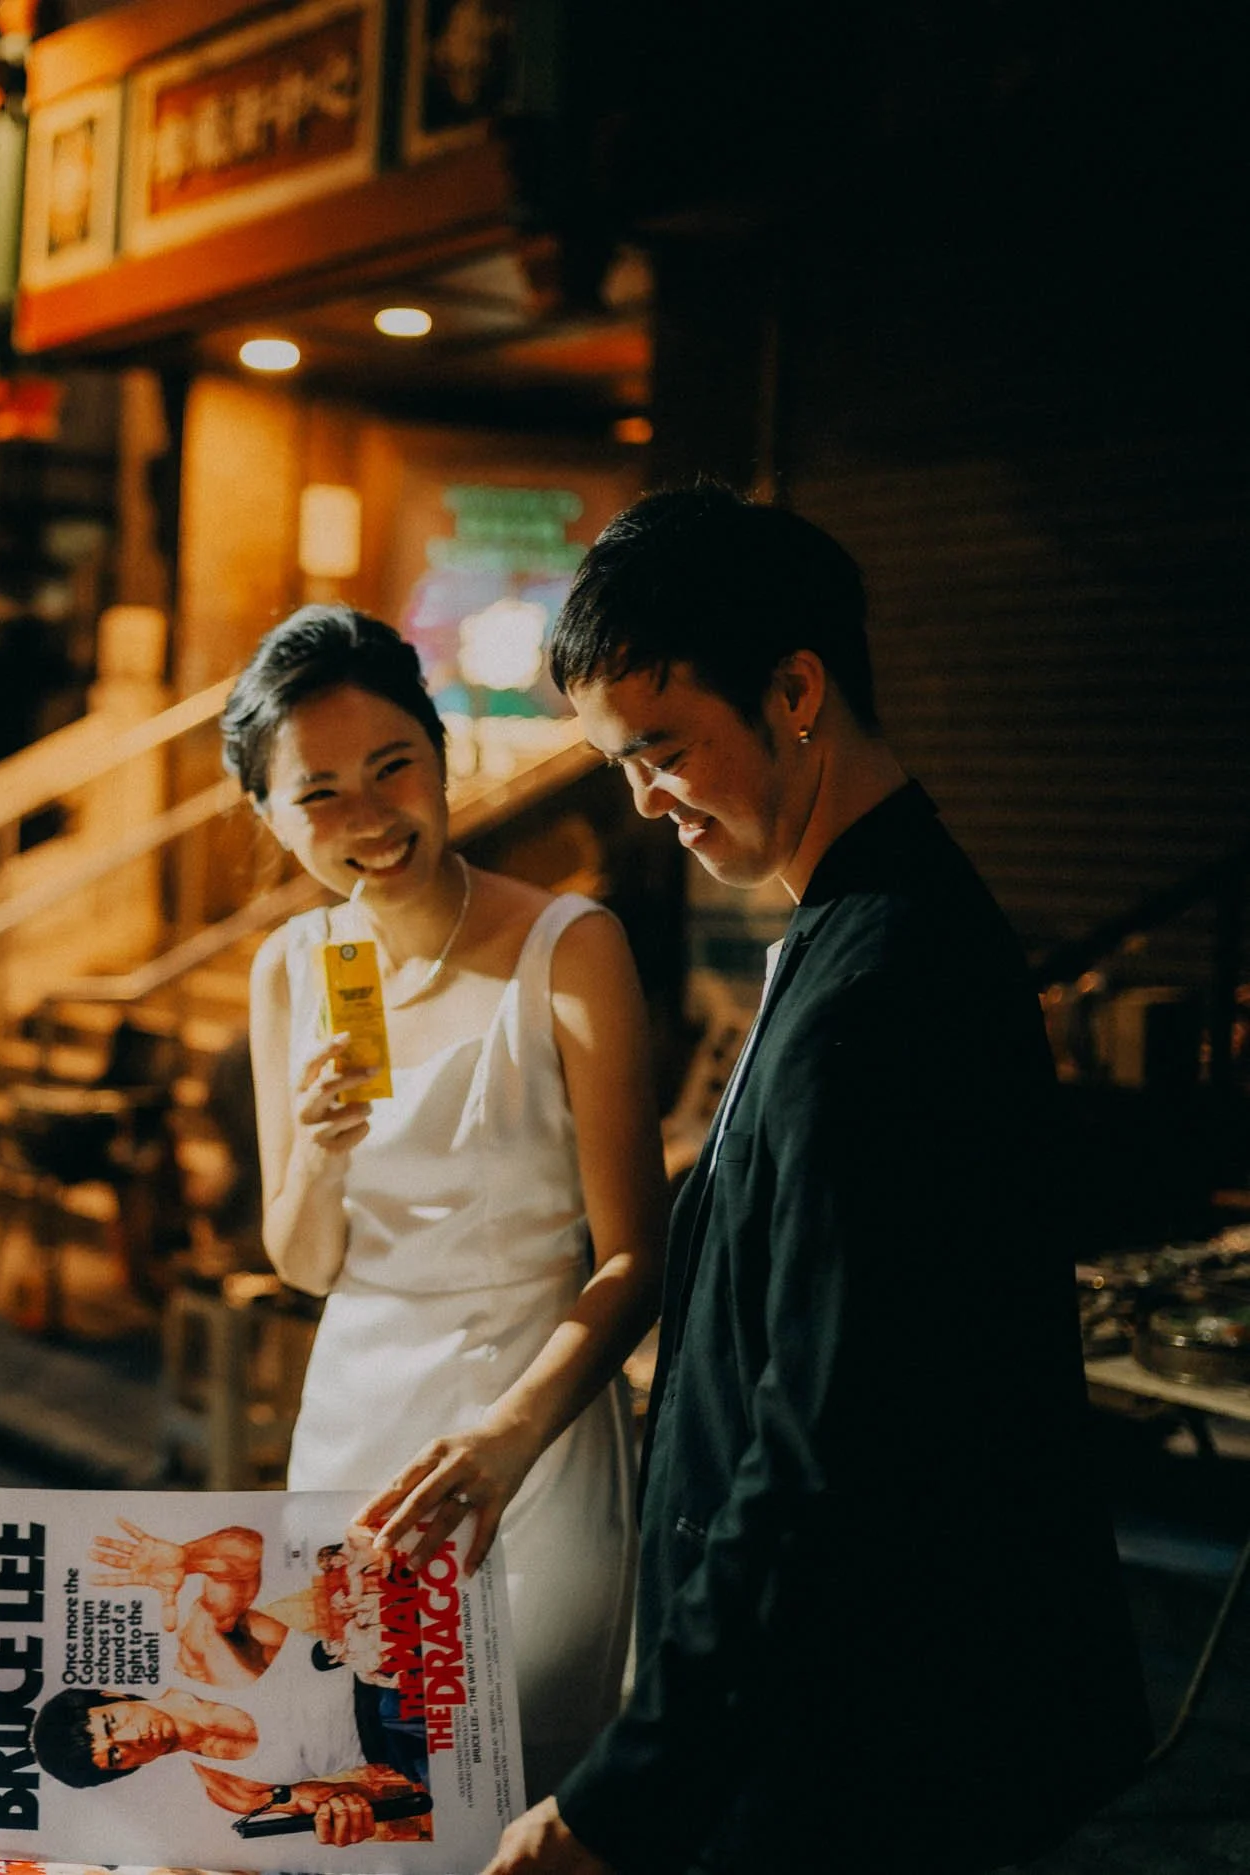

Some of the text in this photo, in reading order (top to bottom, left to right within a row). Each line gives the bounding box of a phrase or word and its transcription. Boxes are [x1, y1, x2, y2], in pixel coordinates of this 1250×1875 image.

[62, 1568, 79, 1685] Once more the
[78, 1600, 95, 1685] Colosseum
[95, 1600, 111, 1685] echoes the
[111, 1604, 126, 1685] sound of a
[127, 1600, 145, 1685] fight to the
[380, 1588, 423, 1673] WAY
[465, 1635, 473, 1650] THE
[144, 1632, 160, 1685] death!
[466, 1653, 474, 1664] OF
[467, 1664, 476, 1685] WAY
[399, 1669, 426, 1720] THE
[427, 1706, 455, 1754] THE
[470, 1716, 479, 1731] LEE
[472, 1733, 482, 1763] BRUCE
